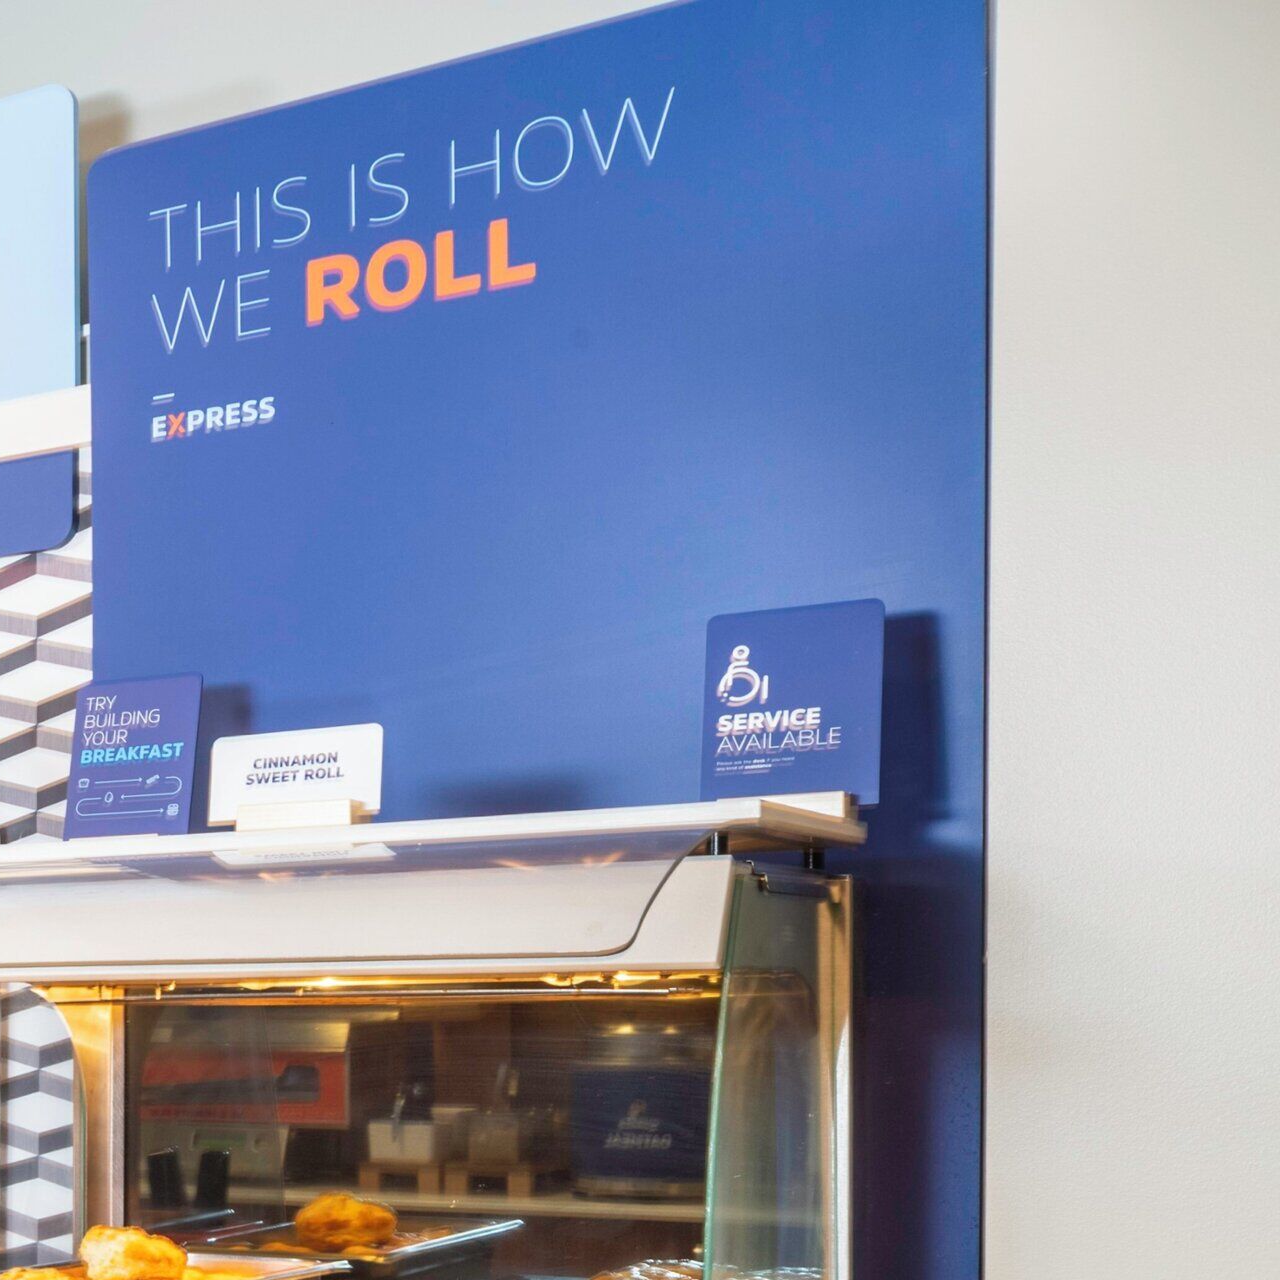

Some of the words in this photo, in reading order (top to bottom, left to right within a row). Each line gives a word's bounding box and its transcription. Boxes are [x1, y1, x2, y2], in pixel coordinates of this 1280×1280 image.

[148, 175, 312, 268] THIS
[351, 152, 410, 228] IS
[450, 87, 675, 206] HOW
[151, 269, 272, 352] WE
[306, 217, 537, 326] ROLL
[151, 396, 276, 440] EXPRESS
[86, 695, 117, 713] TRY
[83, 708, 161, 730] BUILDING
[717, 707, 821, 733] SERVICE
[82, 729, 128, 746] YOUR
[717, 726, 842, 753] AVAILABLE
[79, 741, 185, 766] BREAKFAST
[252, 751, 339, 771] CINNAMON
[245, 767, 298, 786] SWEET
[303, 766, 345, 781] ROLL
